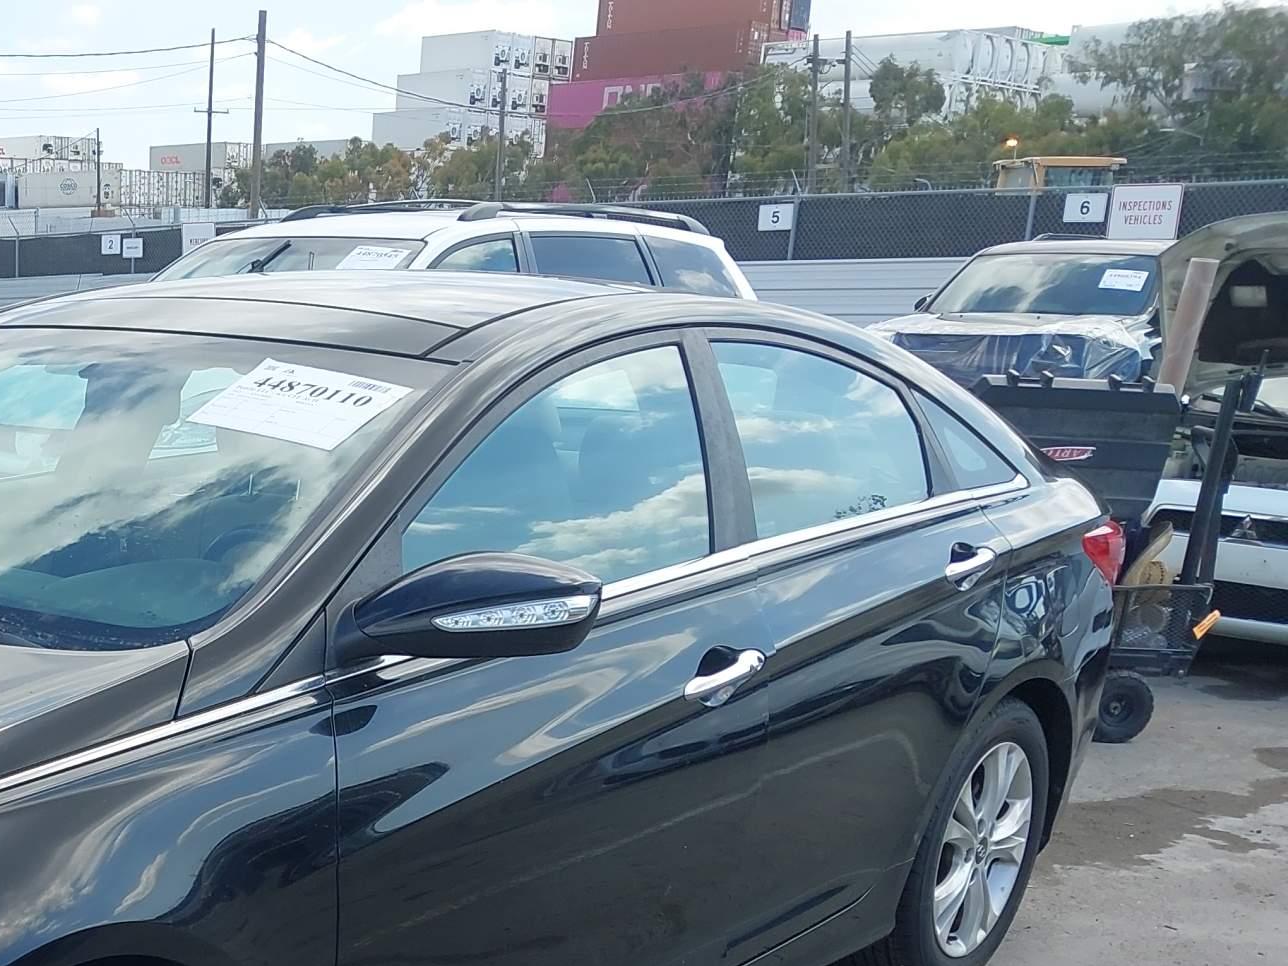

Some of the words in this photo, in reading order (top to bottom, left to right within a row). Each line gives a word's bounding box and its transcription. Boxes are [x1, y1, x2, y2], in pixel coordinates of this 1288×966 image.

[1080, 200, 1091, 215] 6
[1118, 200, 1172, 212] INSPECTIONS
[771, 210, 780, 224] 5
[1124, 214, 1163, 225] VEHICLES
[107, 239, 114, 250] 2
[253, 376, 373, 408] 44870110
